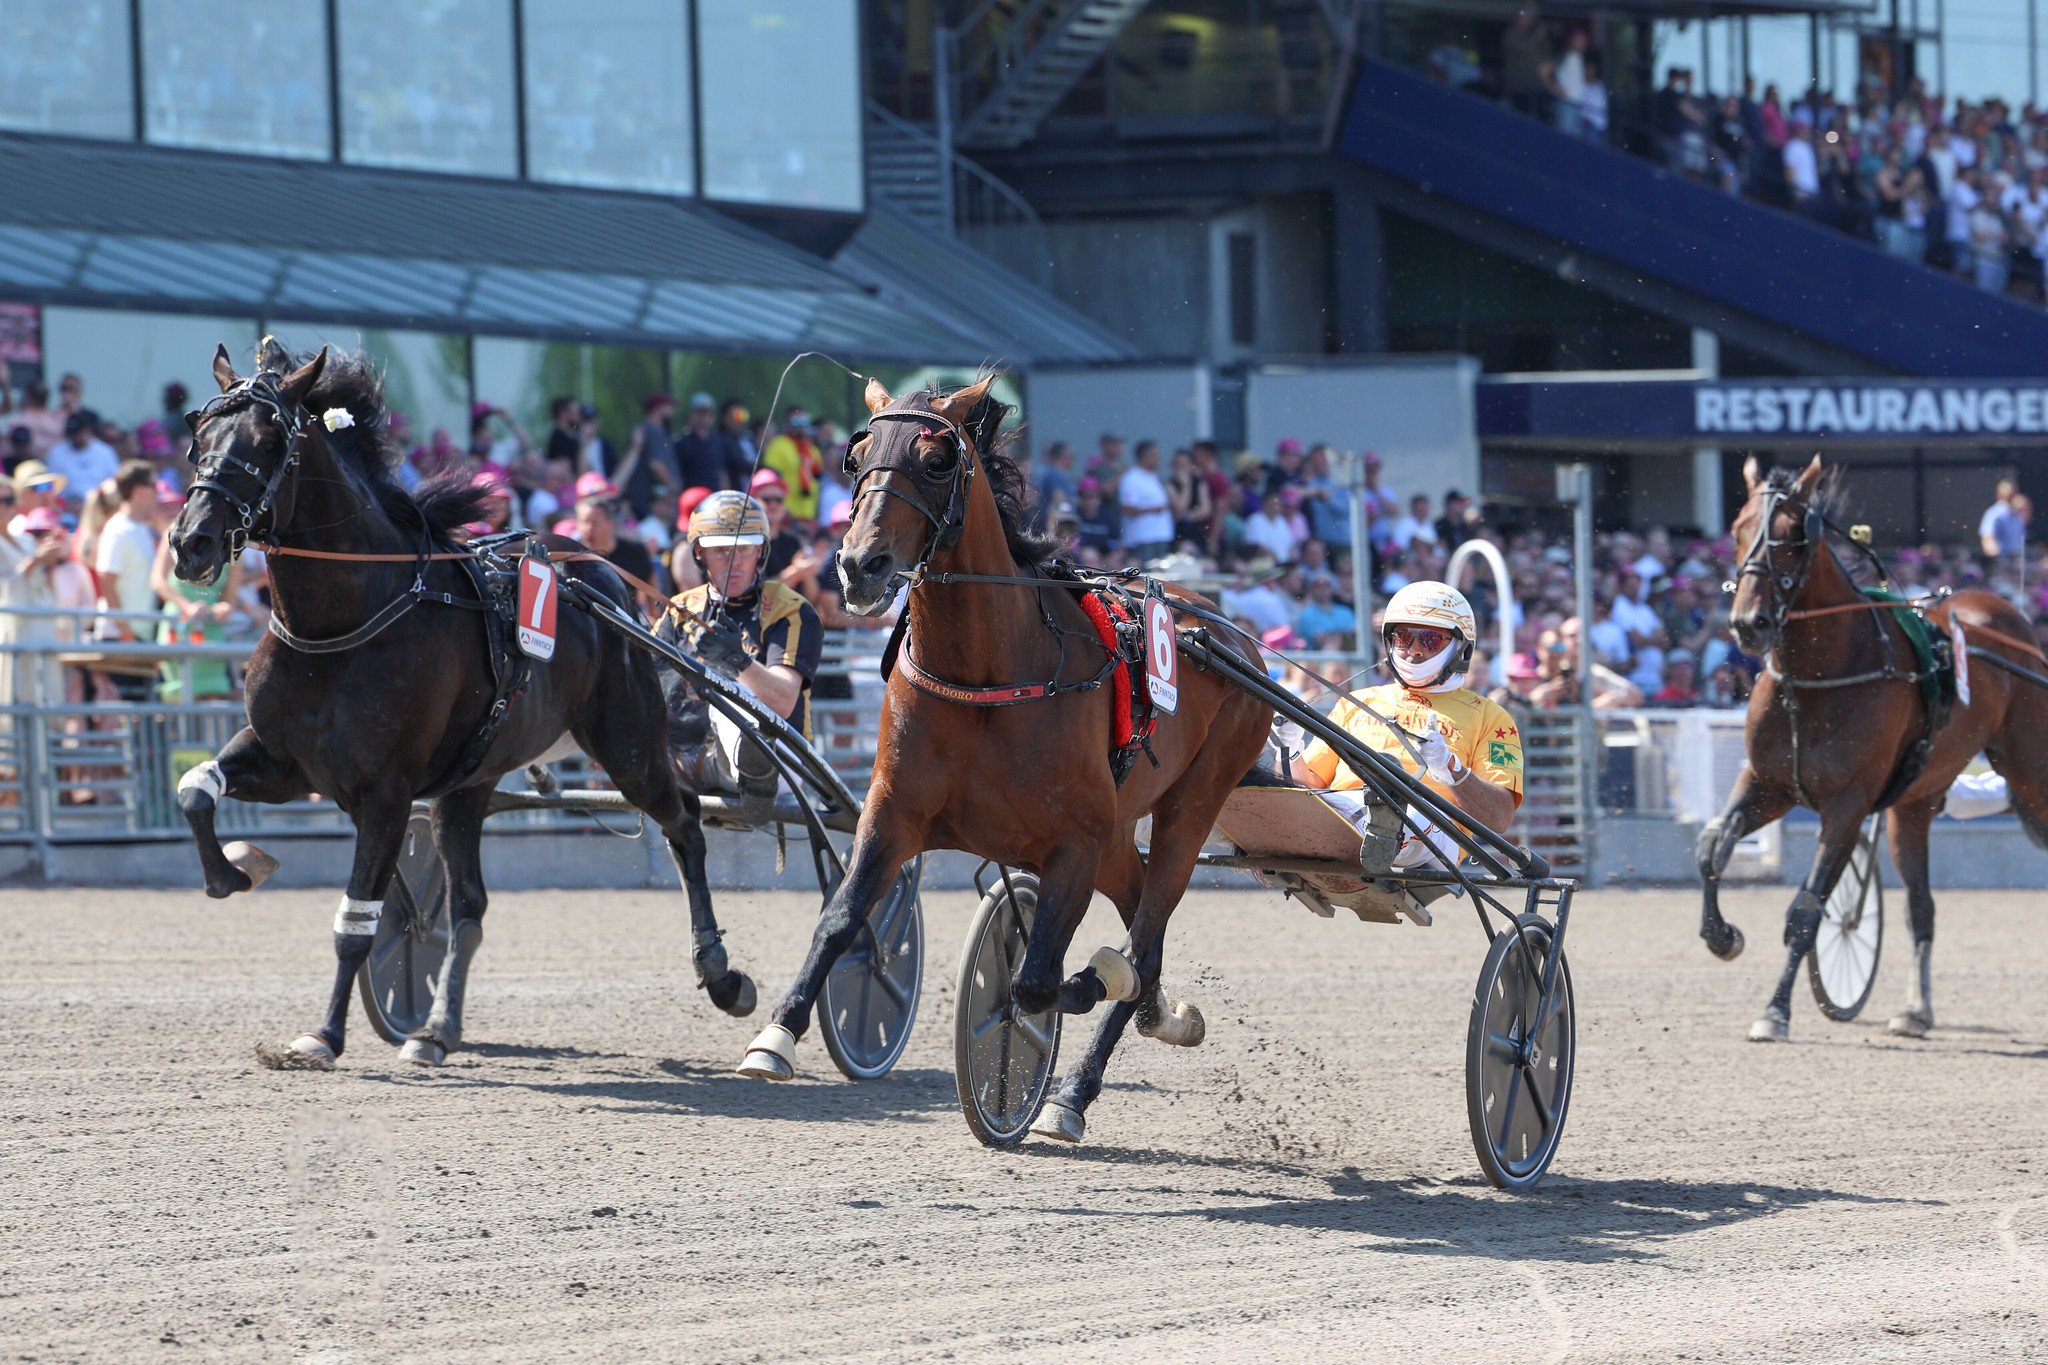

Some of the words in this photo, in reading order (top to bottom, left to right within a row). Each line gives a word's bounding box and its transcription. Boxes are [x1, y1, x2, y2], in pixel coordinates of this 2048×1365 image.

[1695, 388, 2048, 432] RESTAURANGE
[528, 560, 552, 630] 7
[530, 637, 552, 652] FINNTACK
[1152, 603, 1173, 682] 6
[1159, 686, 1176, 703] FINNTACK
